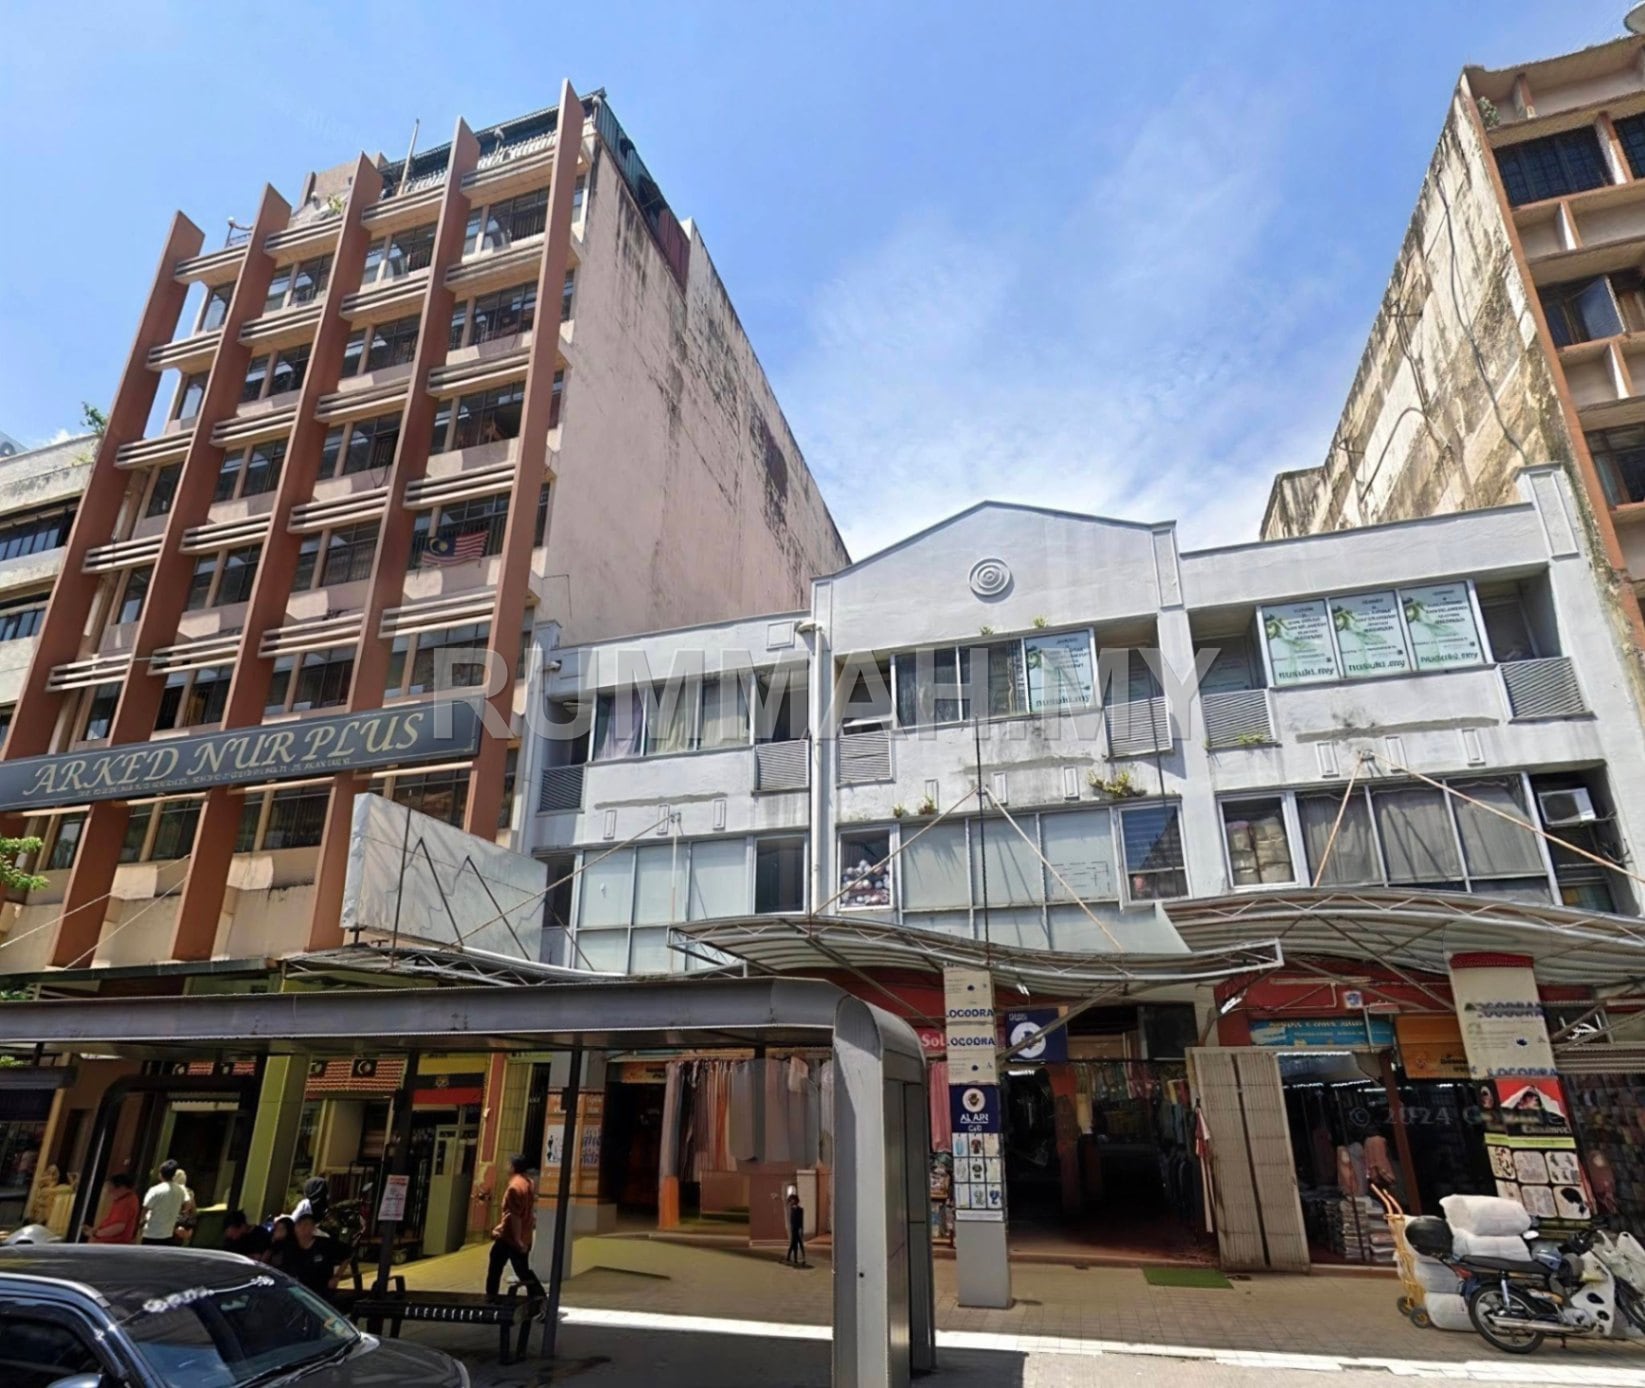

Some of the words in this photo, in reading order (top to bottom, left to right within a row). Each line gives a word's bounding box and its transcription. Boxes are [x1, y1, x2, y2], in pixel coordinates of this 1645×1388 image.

[22, 747, 180, 796] ARKED
[186, 731, 296, 776] NUR
[302, 712, 424, 761] PLUS
